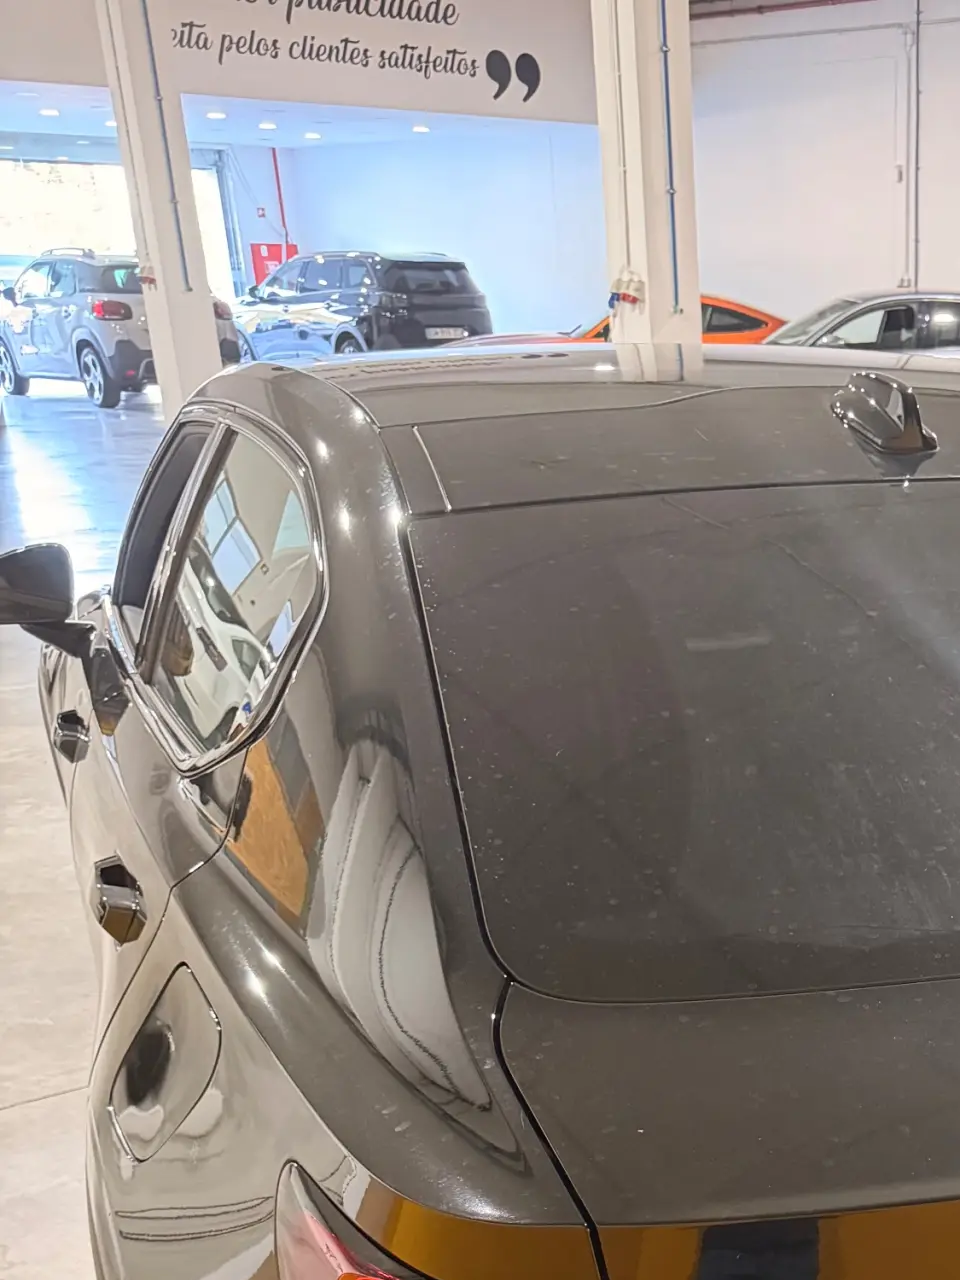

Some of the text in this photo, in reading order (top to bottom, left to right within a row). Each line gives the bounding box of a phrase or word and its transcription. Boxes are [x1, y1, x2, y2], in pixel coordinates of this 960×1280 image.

[218, 30, 280, 66] pelos
[288, 35, 373, 67] clientes
[378, 43, 480, 80] satisfeitos
